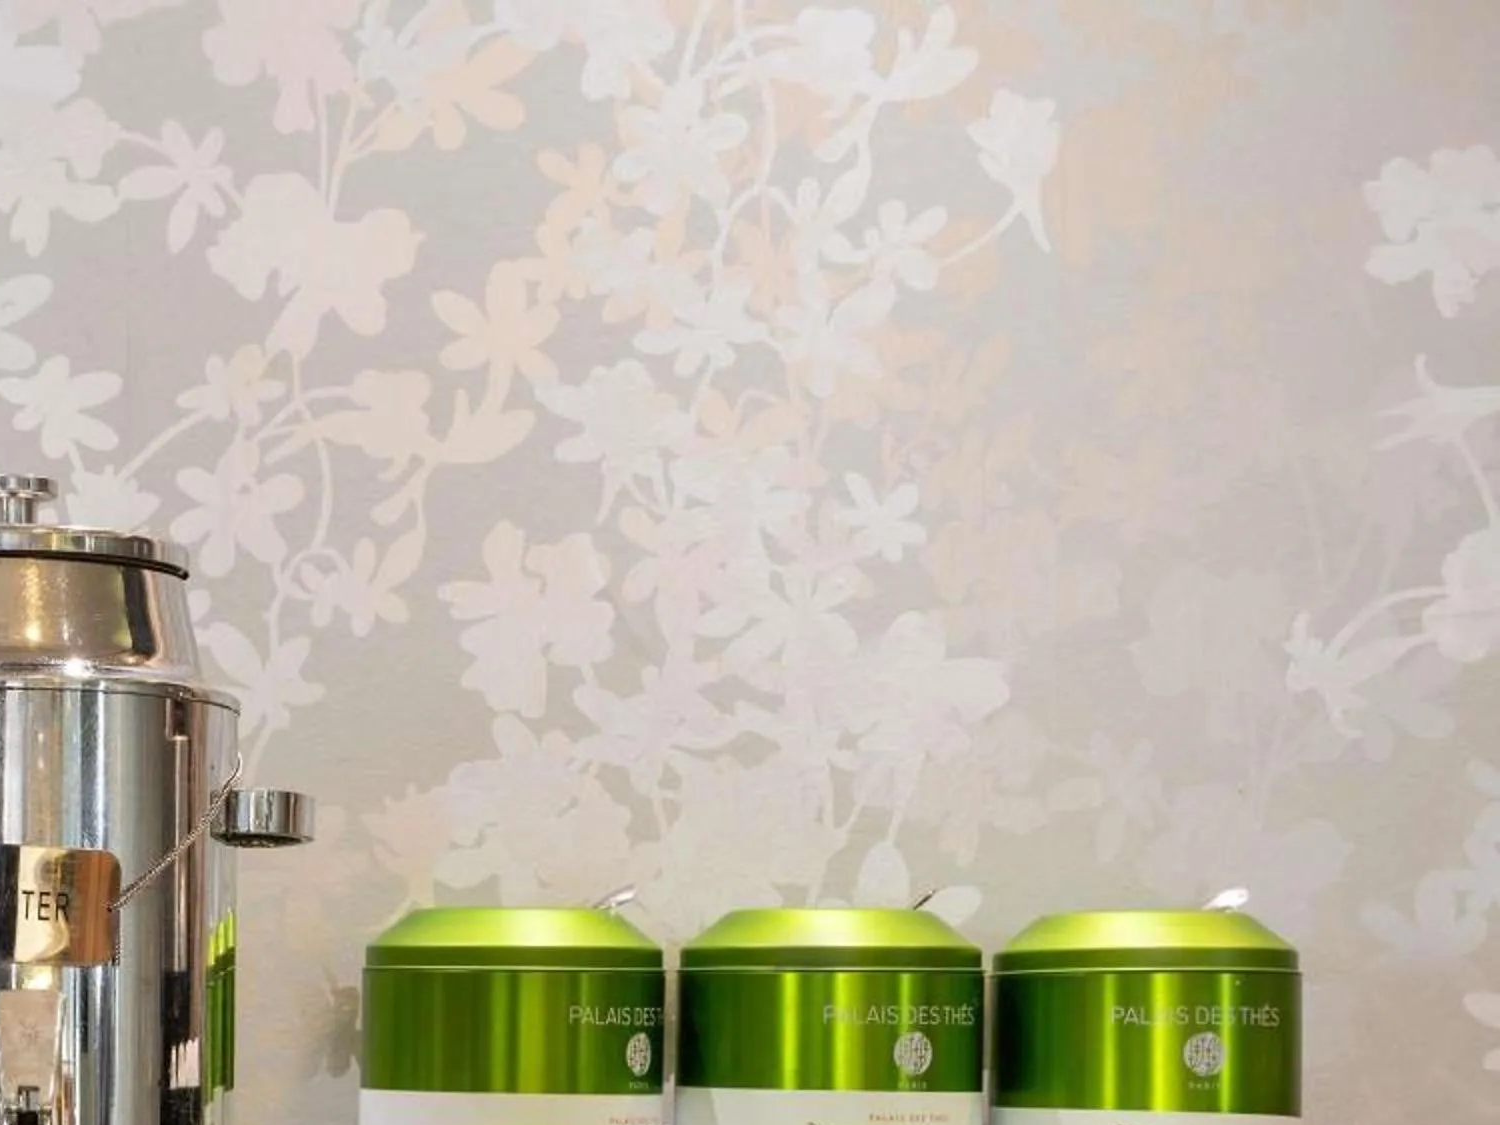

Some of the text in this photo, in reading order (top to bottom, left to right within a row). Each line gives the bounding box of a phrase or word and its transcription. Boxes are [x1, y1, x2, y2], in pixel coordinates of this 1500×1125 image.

[569, 1005, 631, 1026] PALAIS
[634, 1007, 656, 1026] DES
[823, 1005, 898, 1025] PLAIS
[944, 1003, 975, 1025] THÉS
[1111, 1003, 1280, 1027] PALIS DES THÉS
